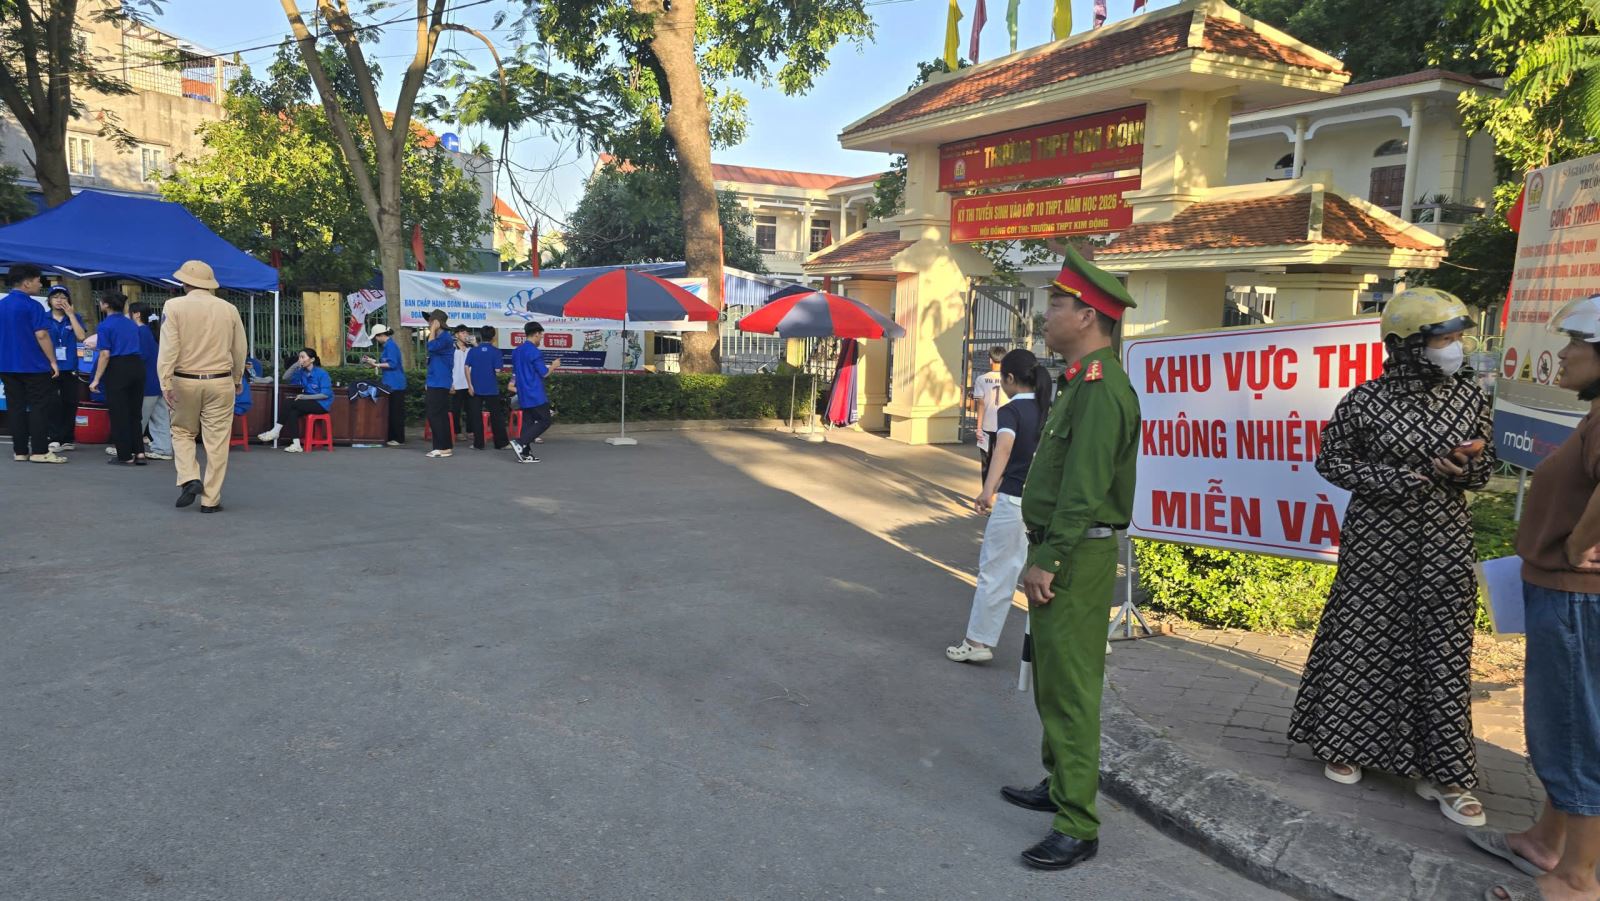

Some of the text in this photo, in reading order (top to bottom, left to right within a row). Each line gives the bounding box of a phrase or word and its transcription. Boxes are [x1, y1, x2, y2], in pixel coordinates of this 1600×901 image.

[1037, 132, 1069, 160] THPT
[1074, 127, 1102, 154] KIM
[1037, 202, 1044, 216] 10
[1065, 196, 1080, 213] NĂM
[1082, 196, 1097, 214] HỌC
[1056, 222, 1072, 231] THPT
[1074, 220, 1087, 230] KIM
[1145, 342, 1383, 400] KHU VỰC THI
[1142, 412, 1227, 459] KHÔNG
[1151, 479, 1262, 537] MIỄN
